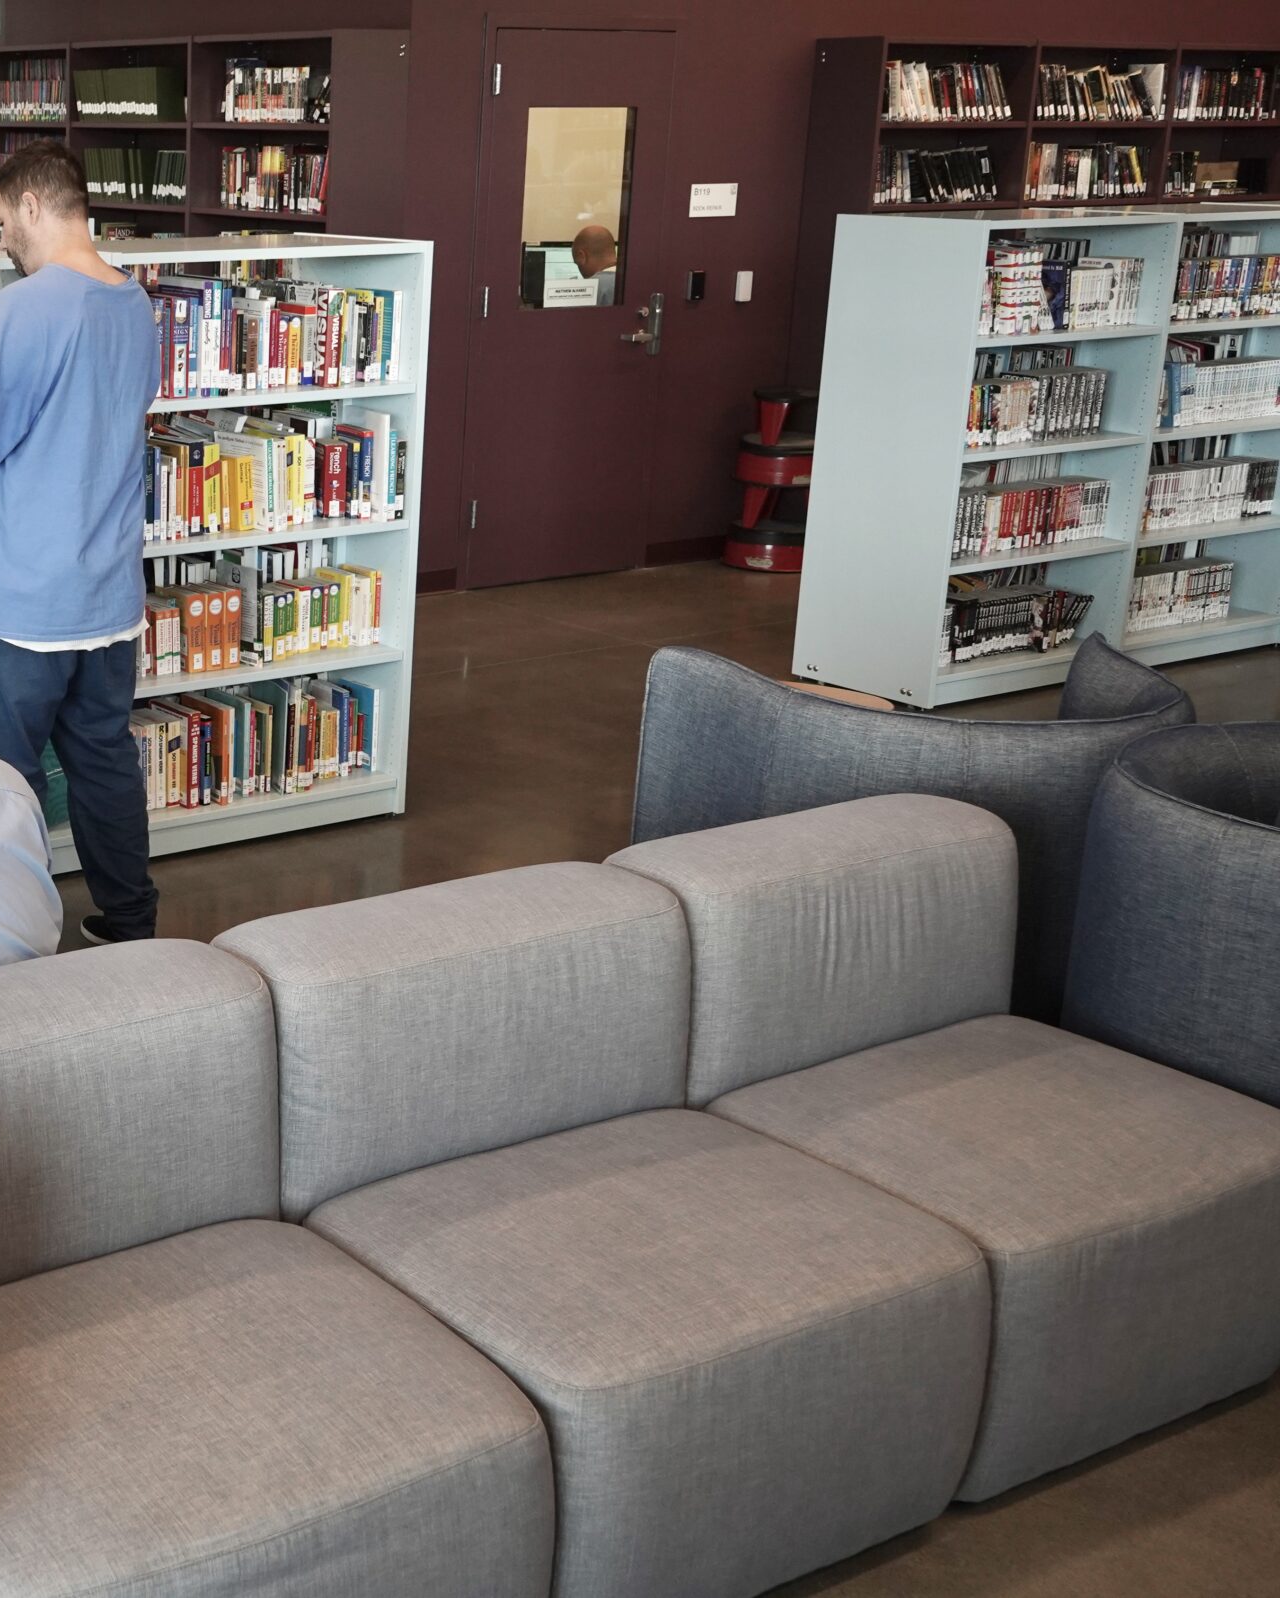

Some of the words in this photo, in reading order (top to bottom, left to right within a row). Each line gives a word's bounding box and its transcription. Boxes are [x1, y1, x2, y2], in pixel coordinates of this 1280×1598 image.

[204, 289, 212, 318] SIGNING
[315, 294, 327, 382] VISUAL
[331, 317, 339, 350] VISUAL
[333, 447, 342, 474] French
